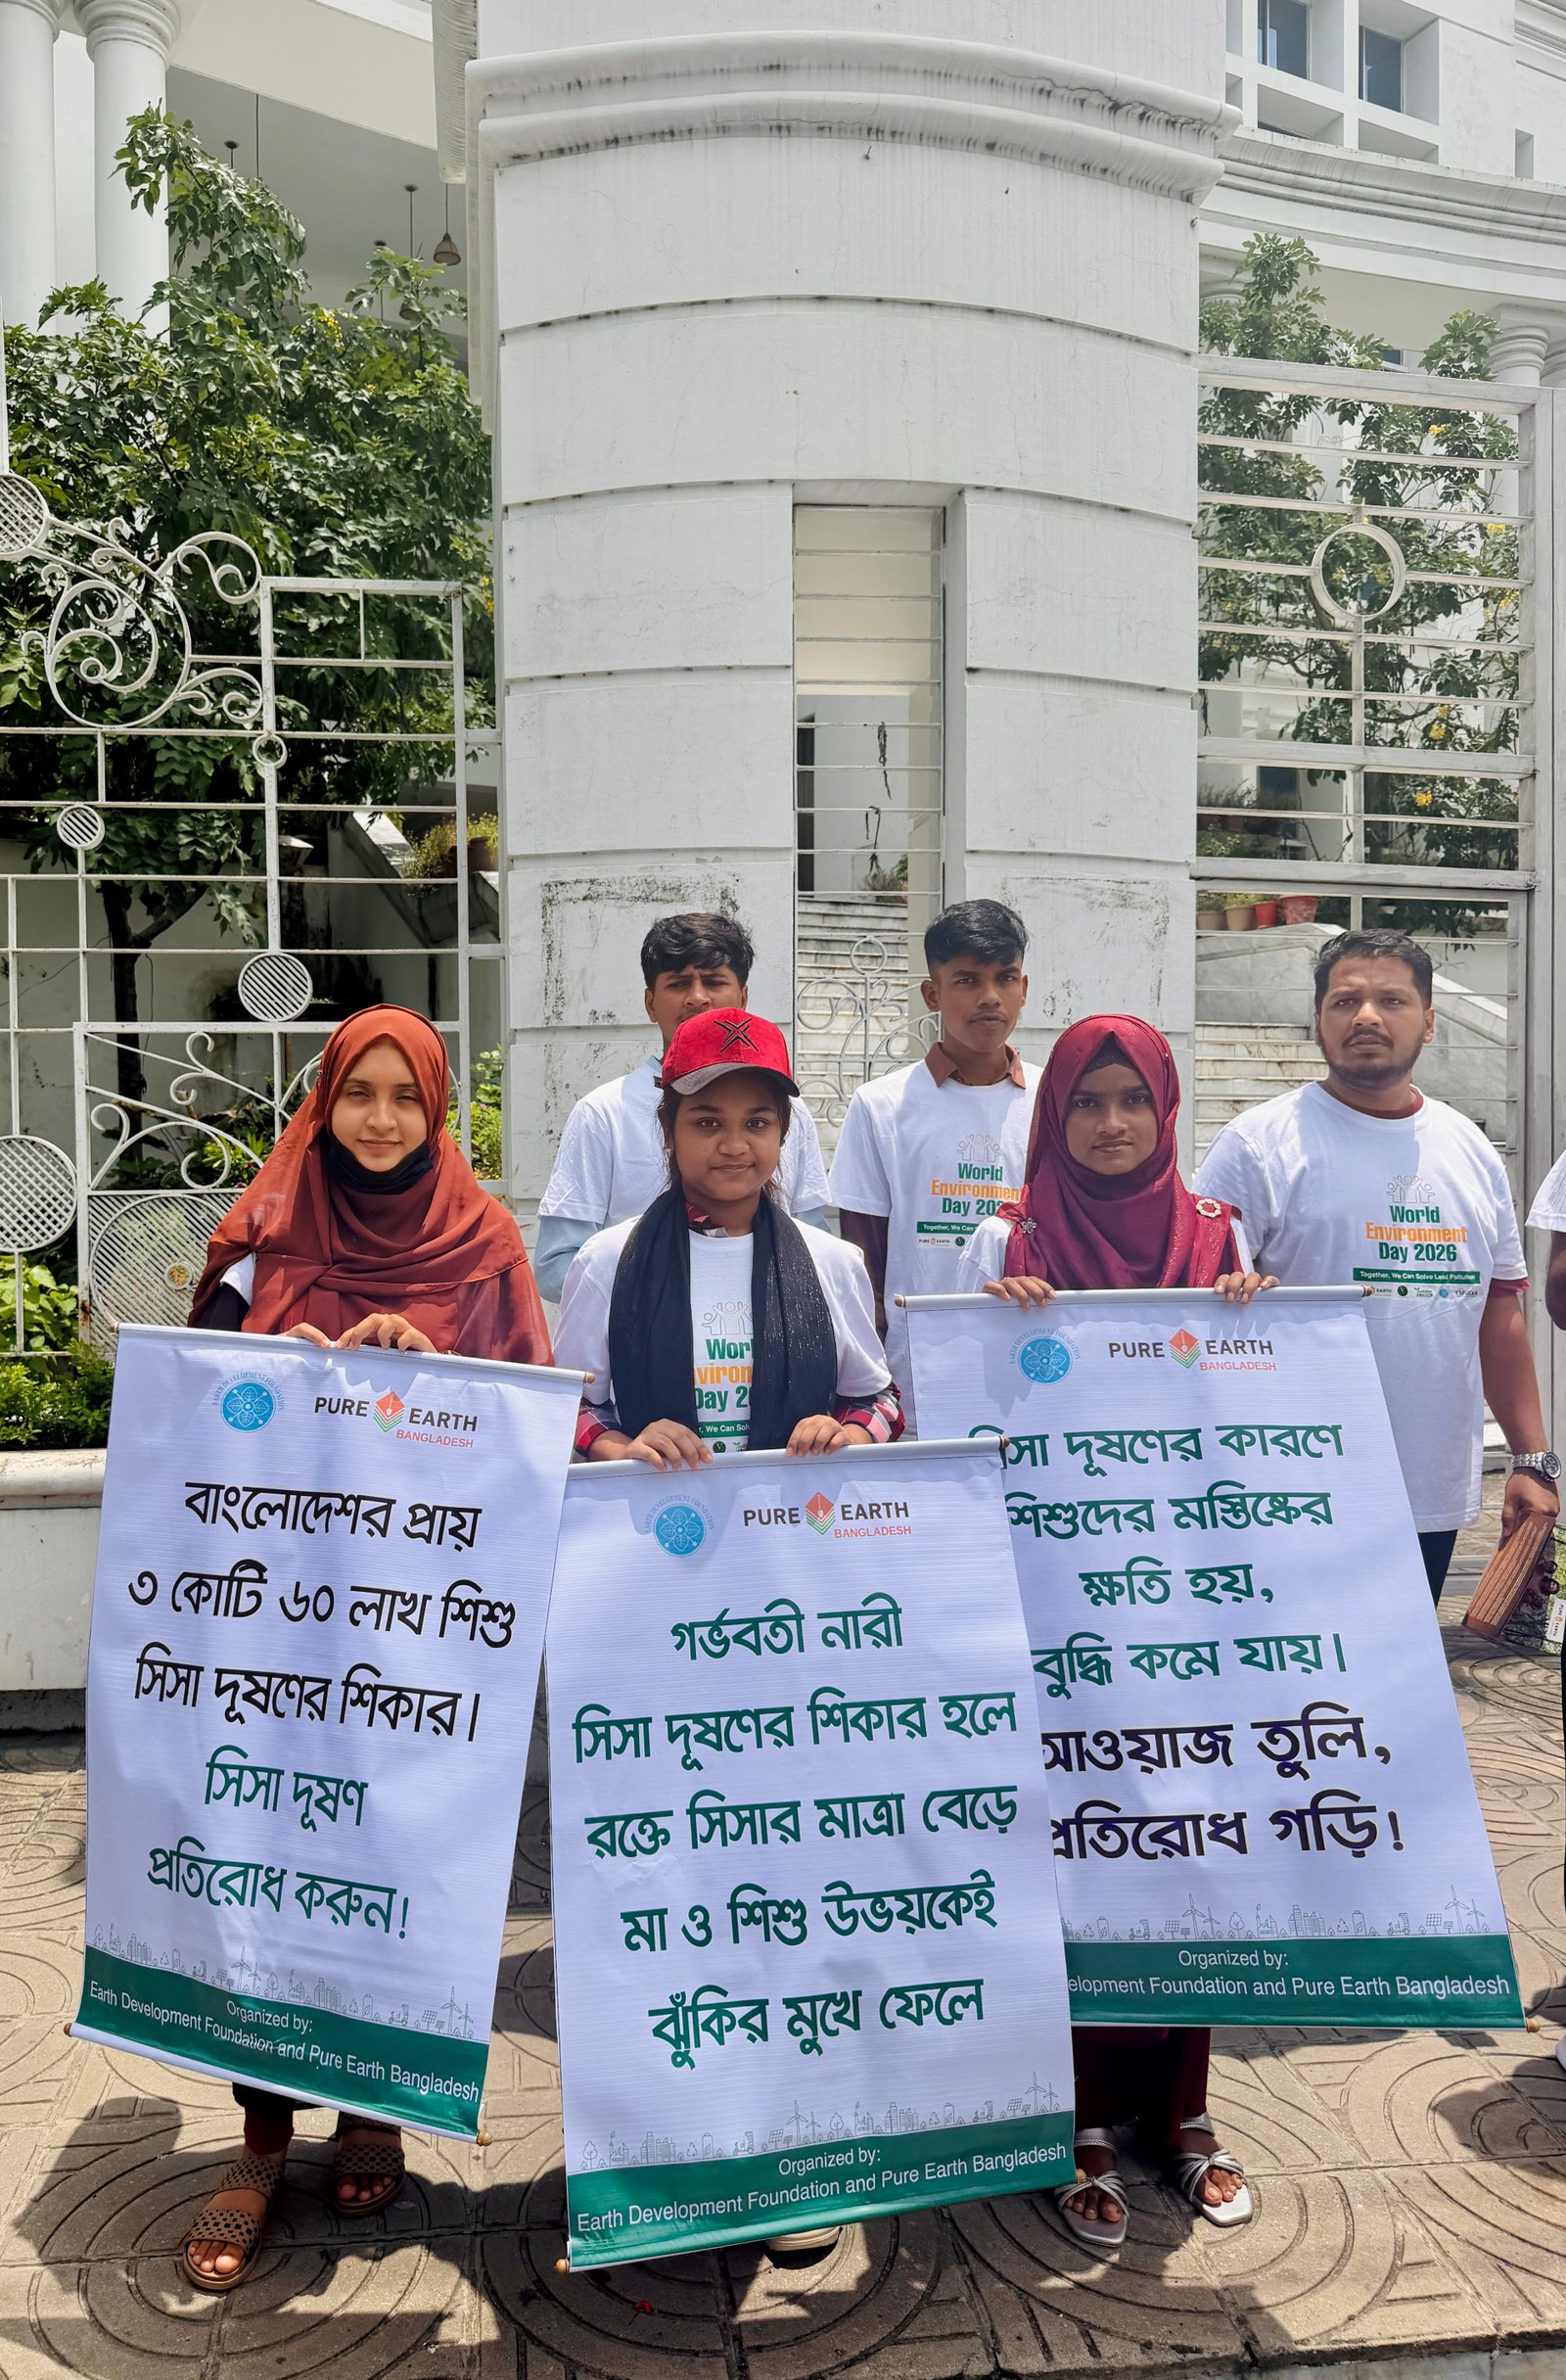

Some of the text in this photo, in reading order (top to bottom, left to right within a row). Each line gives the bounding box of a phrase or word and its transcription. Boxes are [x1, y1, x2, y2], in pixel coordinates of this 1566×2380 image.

[931, 1180, 1019, 1201] Environmen
[958, 1163, 1003, 1181] World
[943, 1198, 970, 1216] Day
[1390, 1205, 1440, 1223] World
[1365, 1222, 1467, 1242] Environment
[1379, 1242, 1456, 1263] Day 2026
[1108, 1339, 1273, 1358] PURE EARTH
[1200, 1361, 1276, 1372] BANGLADESH
[314, 1396, 478, 1432] PURE EARTH
[694, 1388, 728, 1412] Day
[395, 1429, 474, 1449] BANGLADESH
[1064, 1428, 1203, 1476] দূষণের
[1216, 1425, 1344, 1458] কারণে
[403, 1504, 483, 1552] প্রায়
[743, 1502, 909, 1526] PURE EARTH
[834, 1525, 911, 1538] BANGLADESH
[1004, 1480, 1332, 1540] শিশুদের মস্তিষ্কের
[128, 1560, 516, 1648] ৩ কোটি ৬০ লাখ শিশু
[1079, 1556, 1273, 1607] ক্ষতি হয়,
[670, 1592, 902, 1660] গর্ভবতী নারী
[1031, 1632, 1347, 1700] বুদ্ধি কমে যায়।
[135, 1642, 481, 1742] সিসা দূষণের শিকার।
[572, 1687, 1016, 1771] সিসা দূষণের শিকার হলে
[1040, 1701, 1391, 1781] আওয়াজ তুলি,
[205, 1745, 368, 1832] সিসা দূষণ
[584, 1785, 1017, 1859] রক্তে সিসার মাত্রা বেড়ে
[1050, 1789, 1405, 1860] প্রতিরোধ গড়ি!
[148, 1836, 409, 1938] প্রতিরোধ করুন!
[621, 1869, 998, 1952] মা ও শিশু উভয়কেই
[1178, 1950, 1288, 1970] Organized by:
[1068, 1975, 1510, 2000] elopment Foundation and Pure Earth Bangladesh
[226, 2000, 313, 2034] Organized by:
[648, 1979, 984, 2070] ঝুঁকির মুখে ফেলে
[90, 1980, 480, 2103] Earth Development Foundation and Pure Earth Bangladesh
[779, 2146, 881, 2176] Organized by:
[577, 2142, 1067, 2232] Earth Development Foundation and Pure Earth Bangladesh
